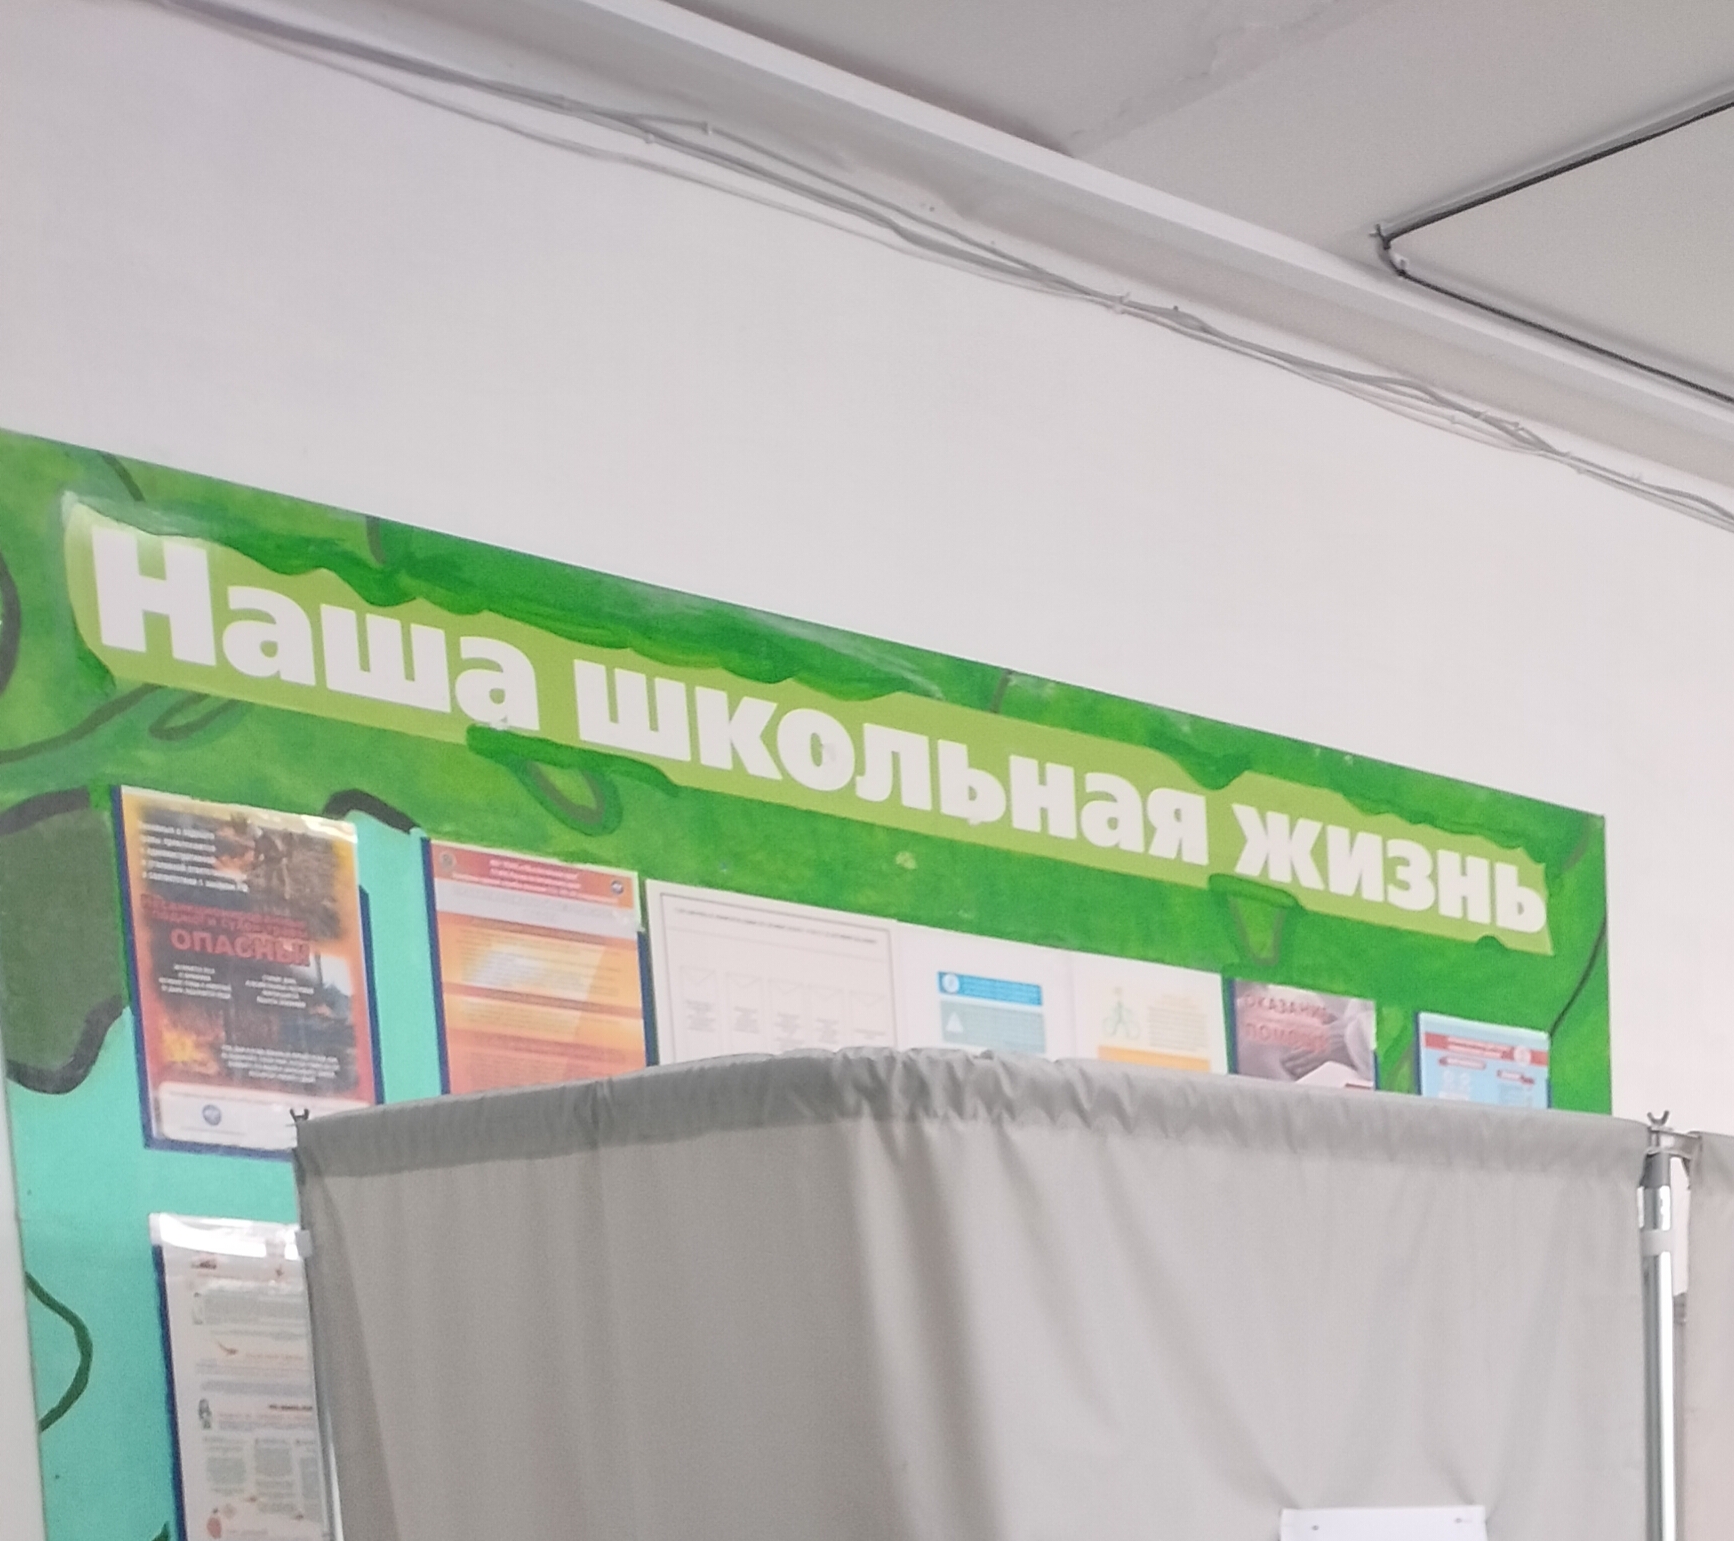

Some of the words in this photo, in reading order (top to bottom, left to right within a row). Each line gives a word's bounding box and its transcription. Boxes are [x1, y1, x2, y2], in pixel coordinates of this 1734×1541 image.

[91, 526, 539, 731] Наша
[573, 660, 1209, 867] школьная
[1231, 803, 1546, 935] жизнь
